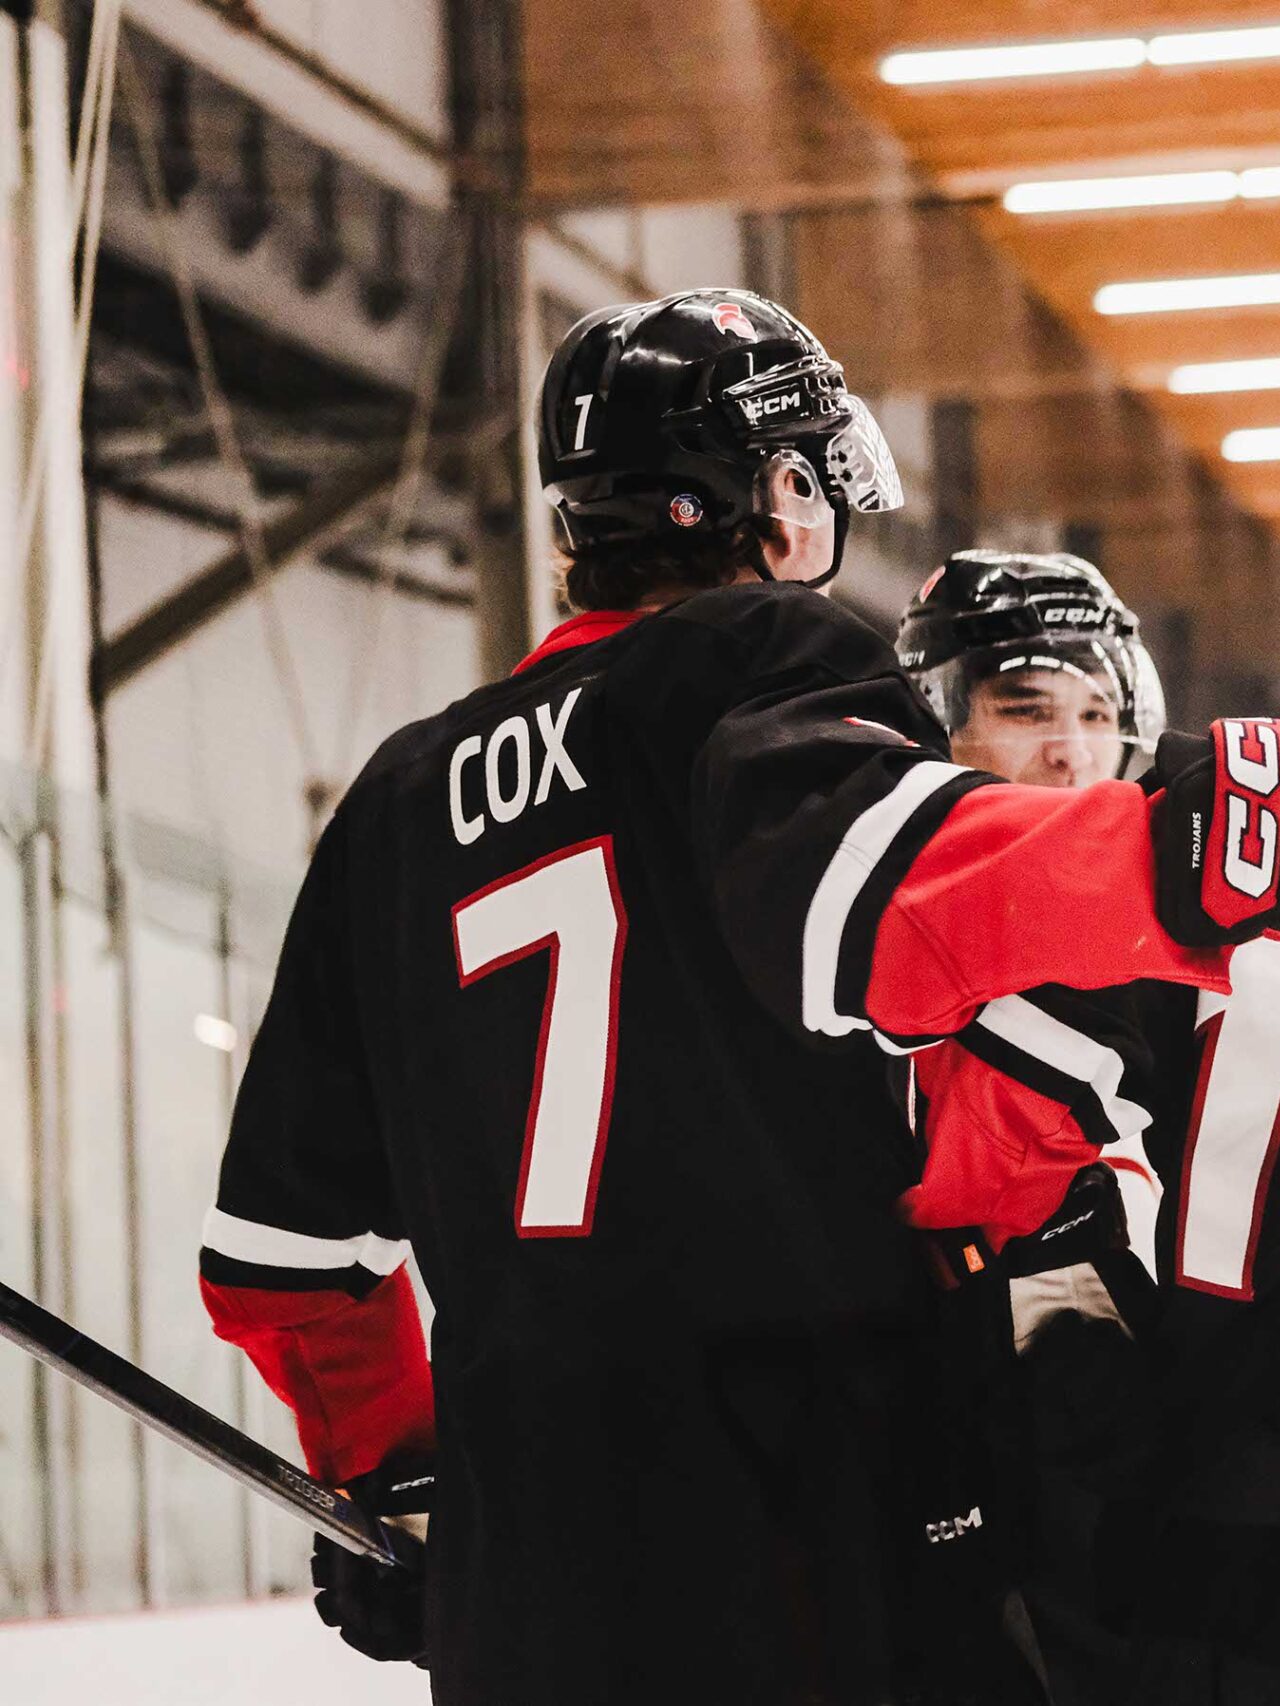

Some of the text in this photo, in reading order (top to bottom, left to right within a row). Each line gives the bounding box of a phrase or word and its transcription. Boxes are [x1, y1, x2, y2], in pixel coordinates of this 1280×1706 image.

[574, 393, 593, 451] 7
[746, 391, 801, 421] CCM
[449, 687, 587, 845] COX
[1223, 717, 1280, 899] CC
[1192, 812, 1202, 869] TROJANS
[451, 834, 628, 1238] 7
[925, 1506, 984, 1543] CCM
